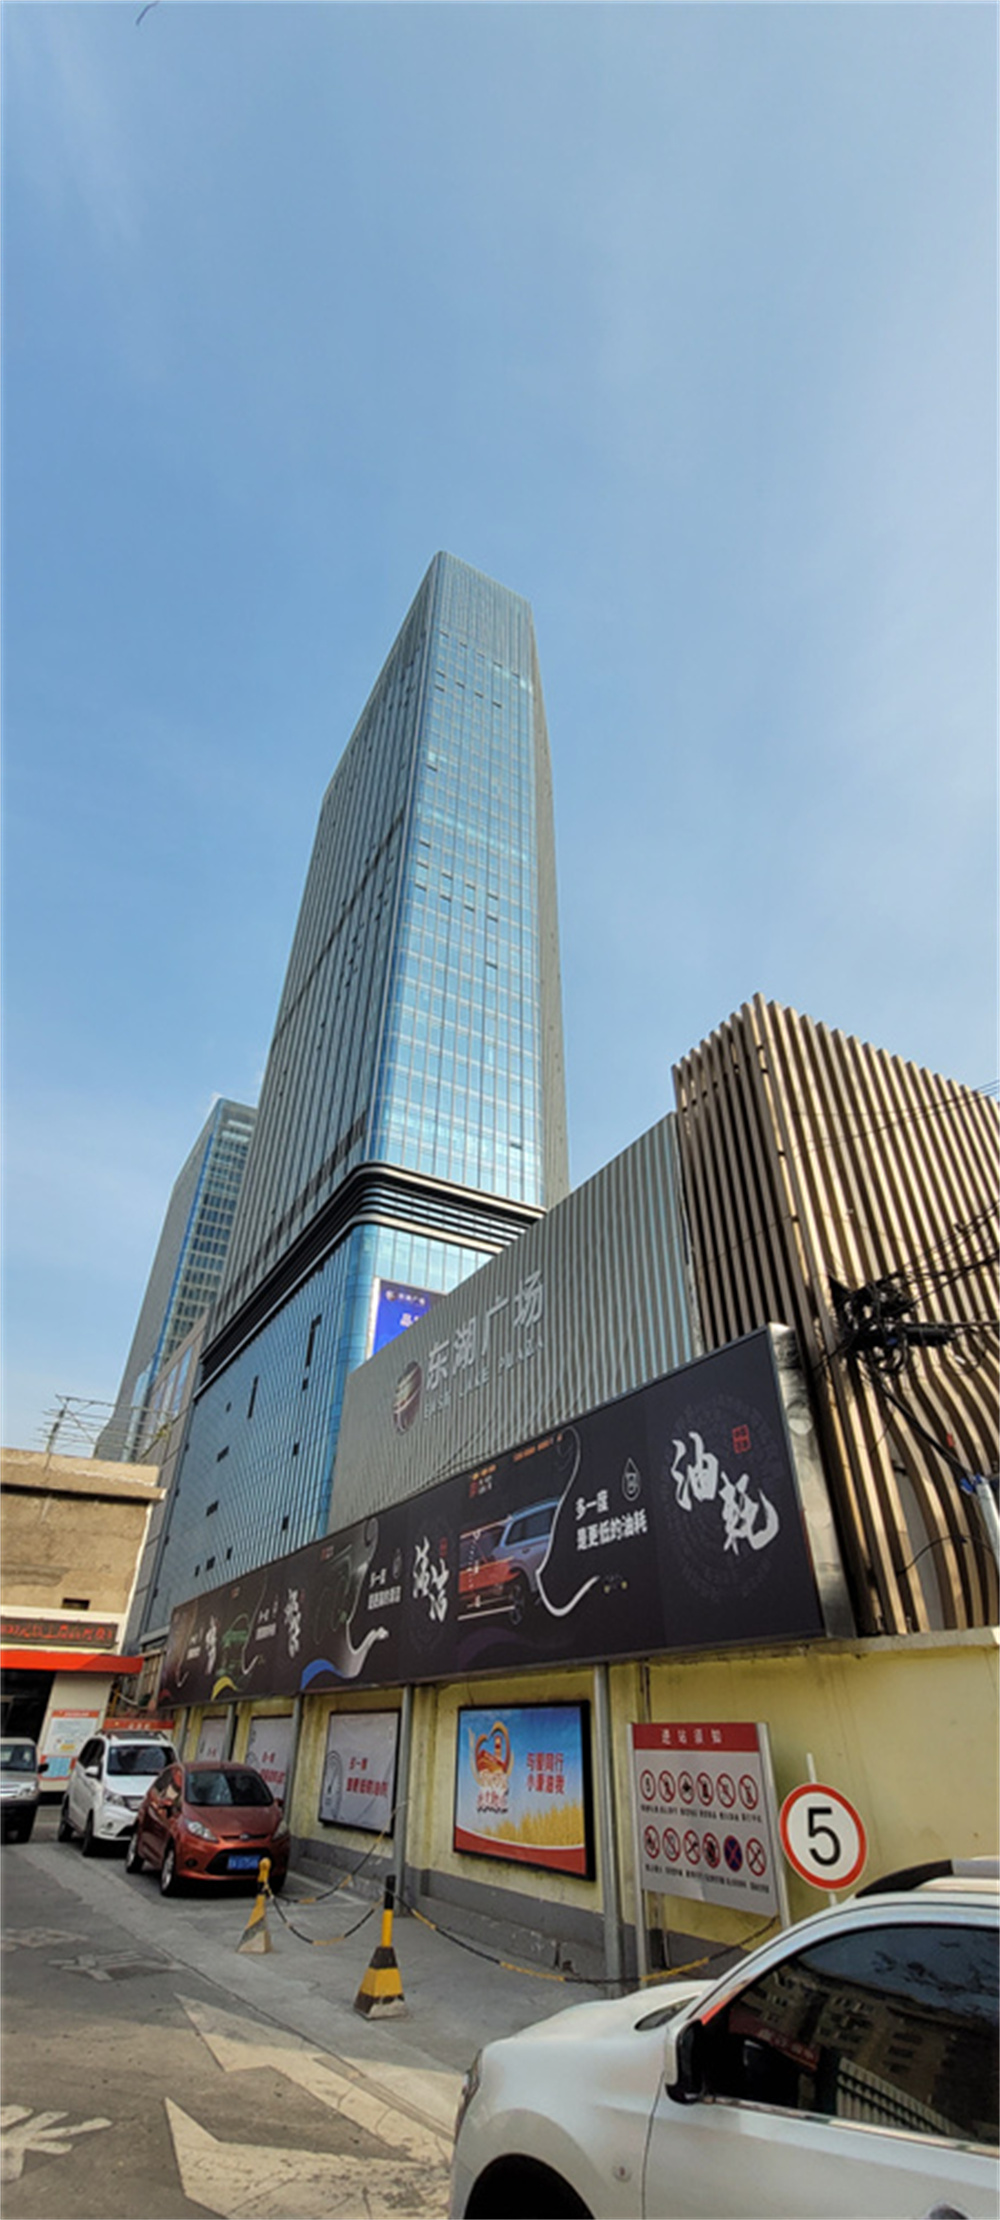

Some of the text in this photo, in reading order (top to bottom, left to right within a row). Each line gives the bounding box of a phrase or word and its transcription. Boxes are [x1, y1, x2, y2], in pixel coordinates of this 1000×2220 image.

[426, 1269, 544, 1391] 东湖广场
[575, 1489, 609, 1521] 多一度
[670, 1431, 779, 1556] 油耗
[808, 1806, 841, 1867] 5
